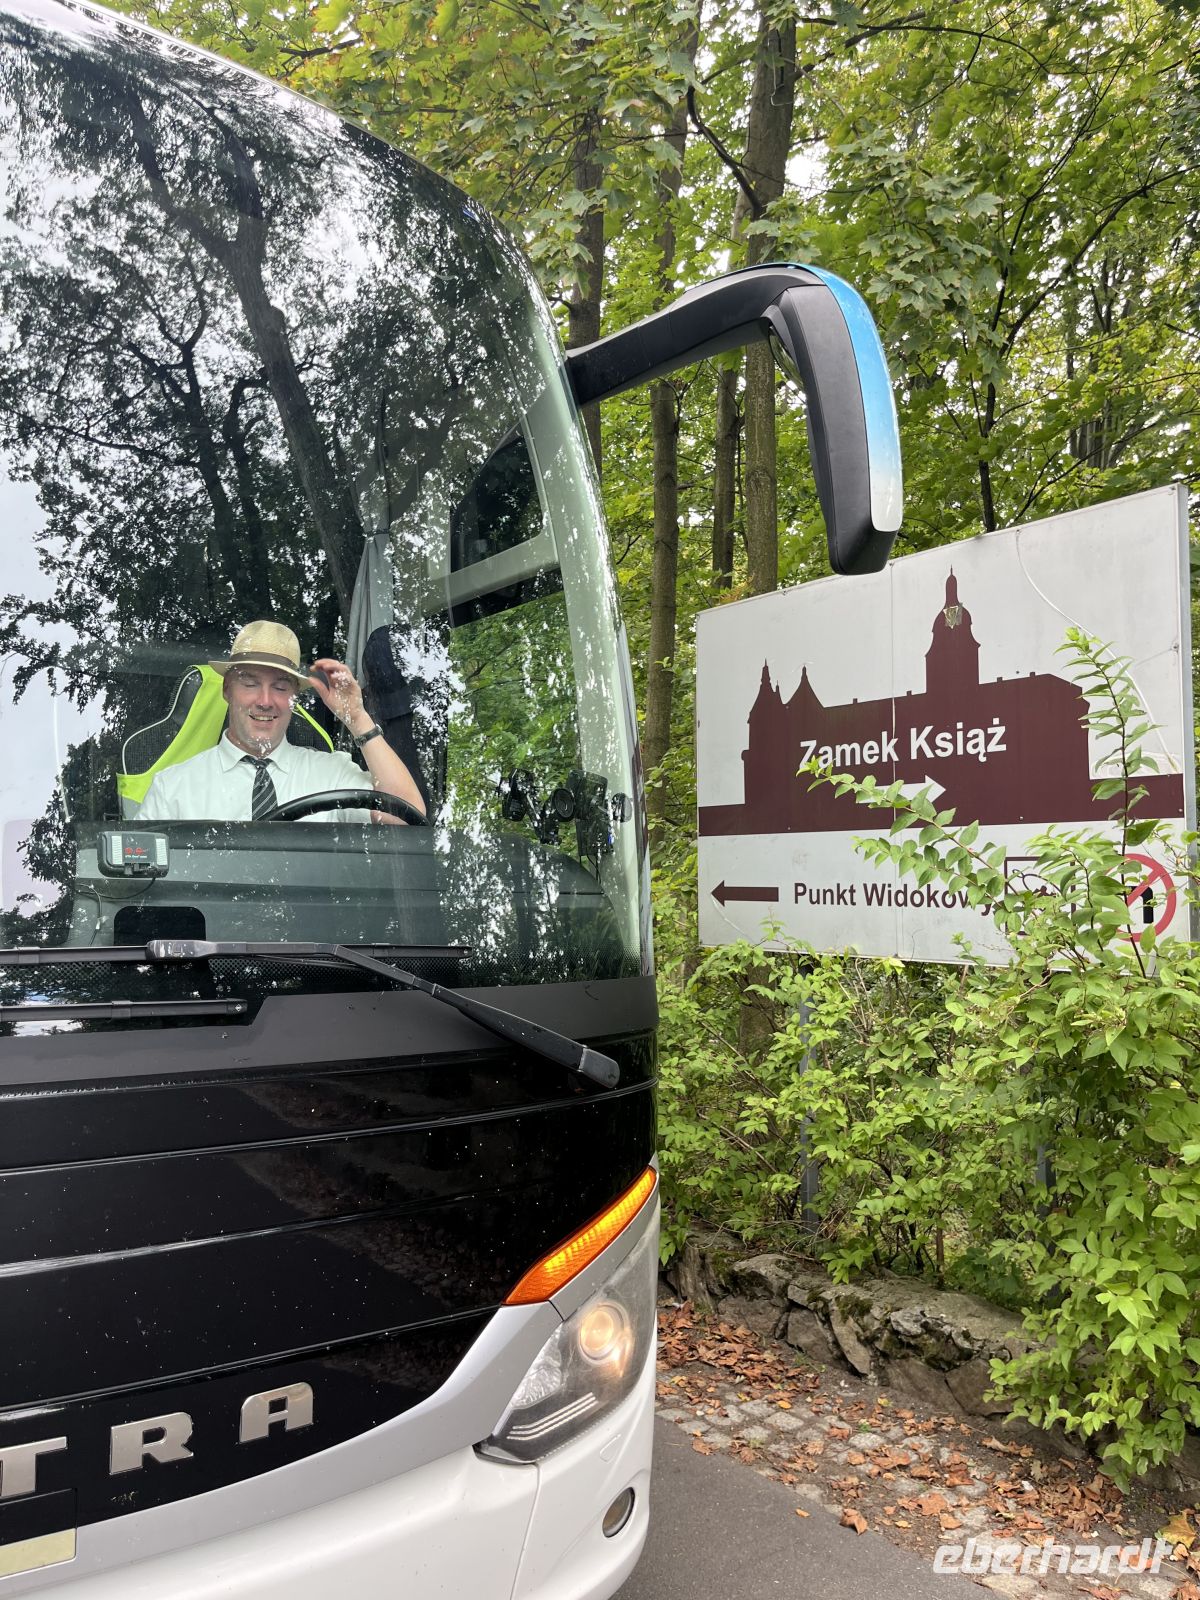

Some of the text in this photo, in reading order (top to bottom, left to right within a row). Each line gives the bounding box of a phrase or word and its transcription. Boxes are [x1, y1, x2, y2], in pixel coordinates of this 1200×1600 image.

[799, 718, 1007, 769] Zamek Książ
[794, 882, 857, 906] Punkt
